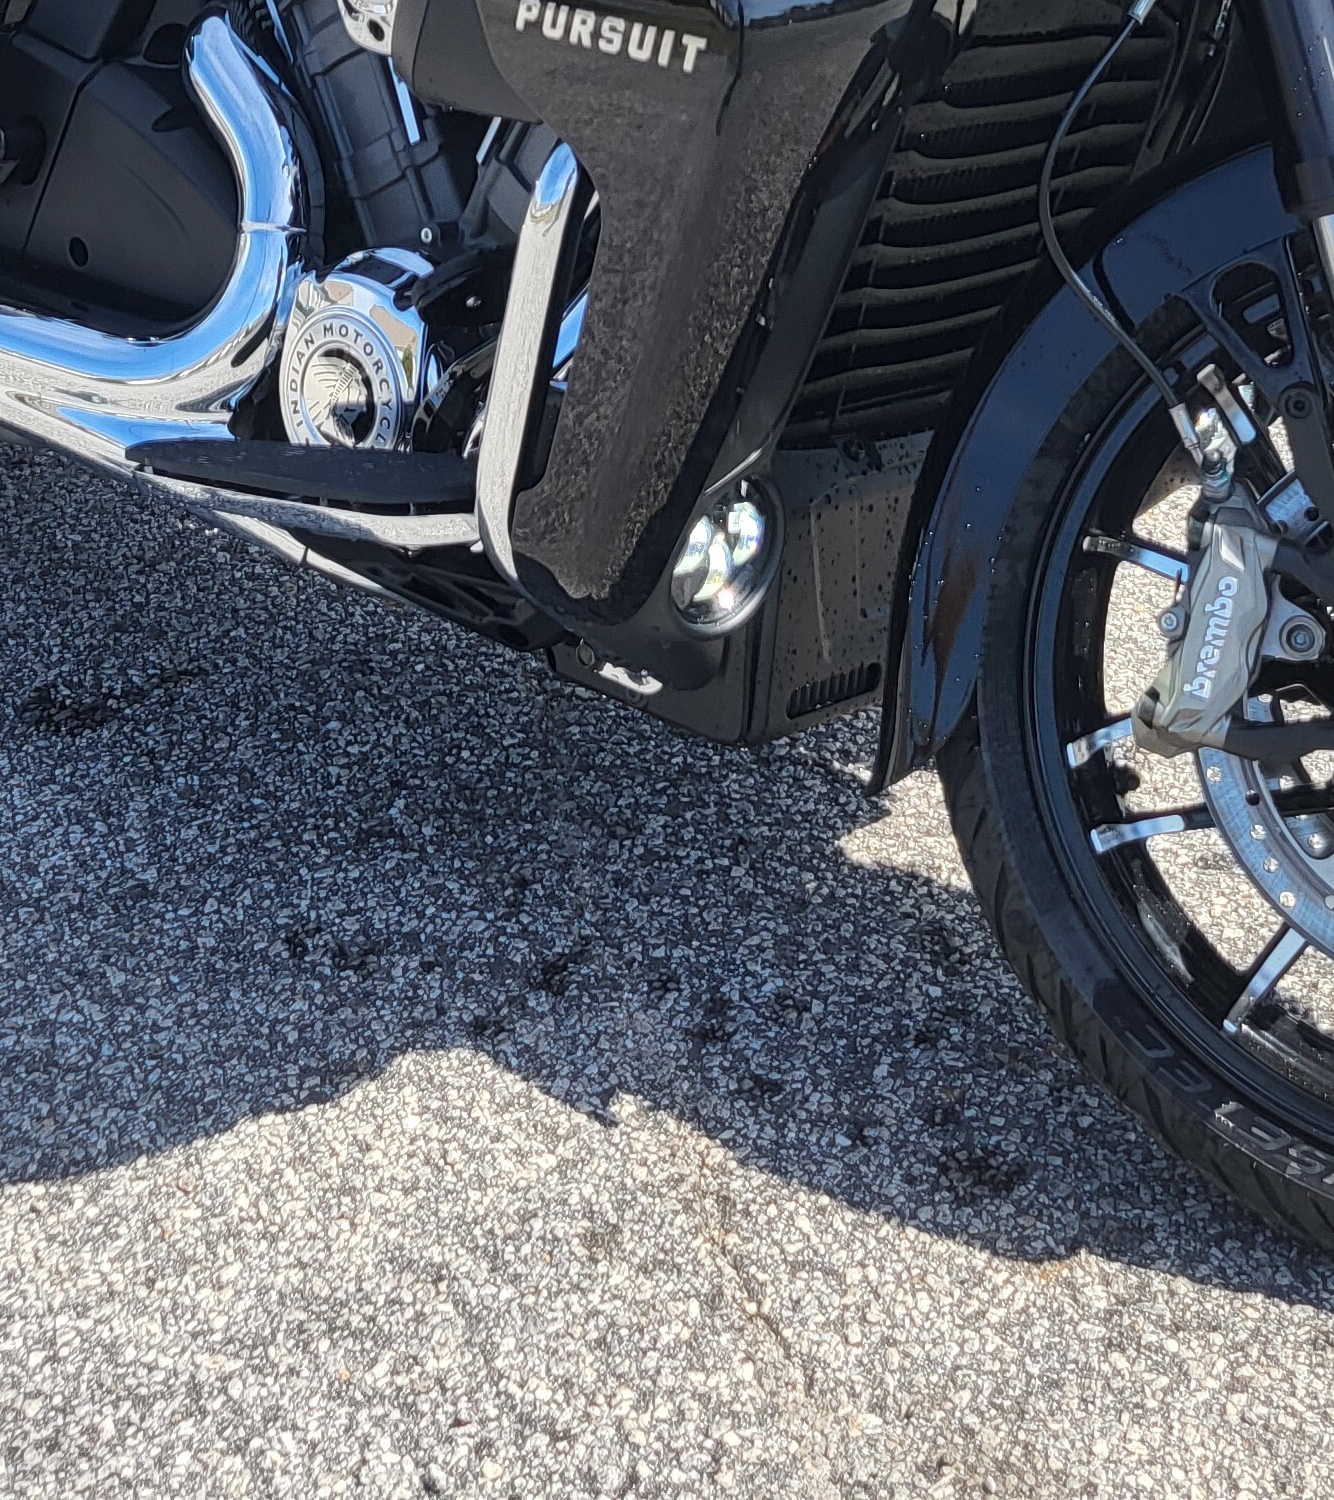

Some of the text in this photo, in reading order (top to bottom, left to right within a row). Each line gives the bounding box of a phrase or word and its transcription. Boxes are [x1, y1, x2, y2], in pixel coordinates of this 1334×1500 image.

[289, 322, 393, 447] INDIAN MOTORCYCL
[1183, 575, 1239, 699] brembo
